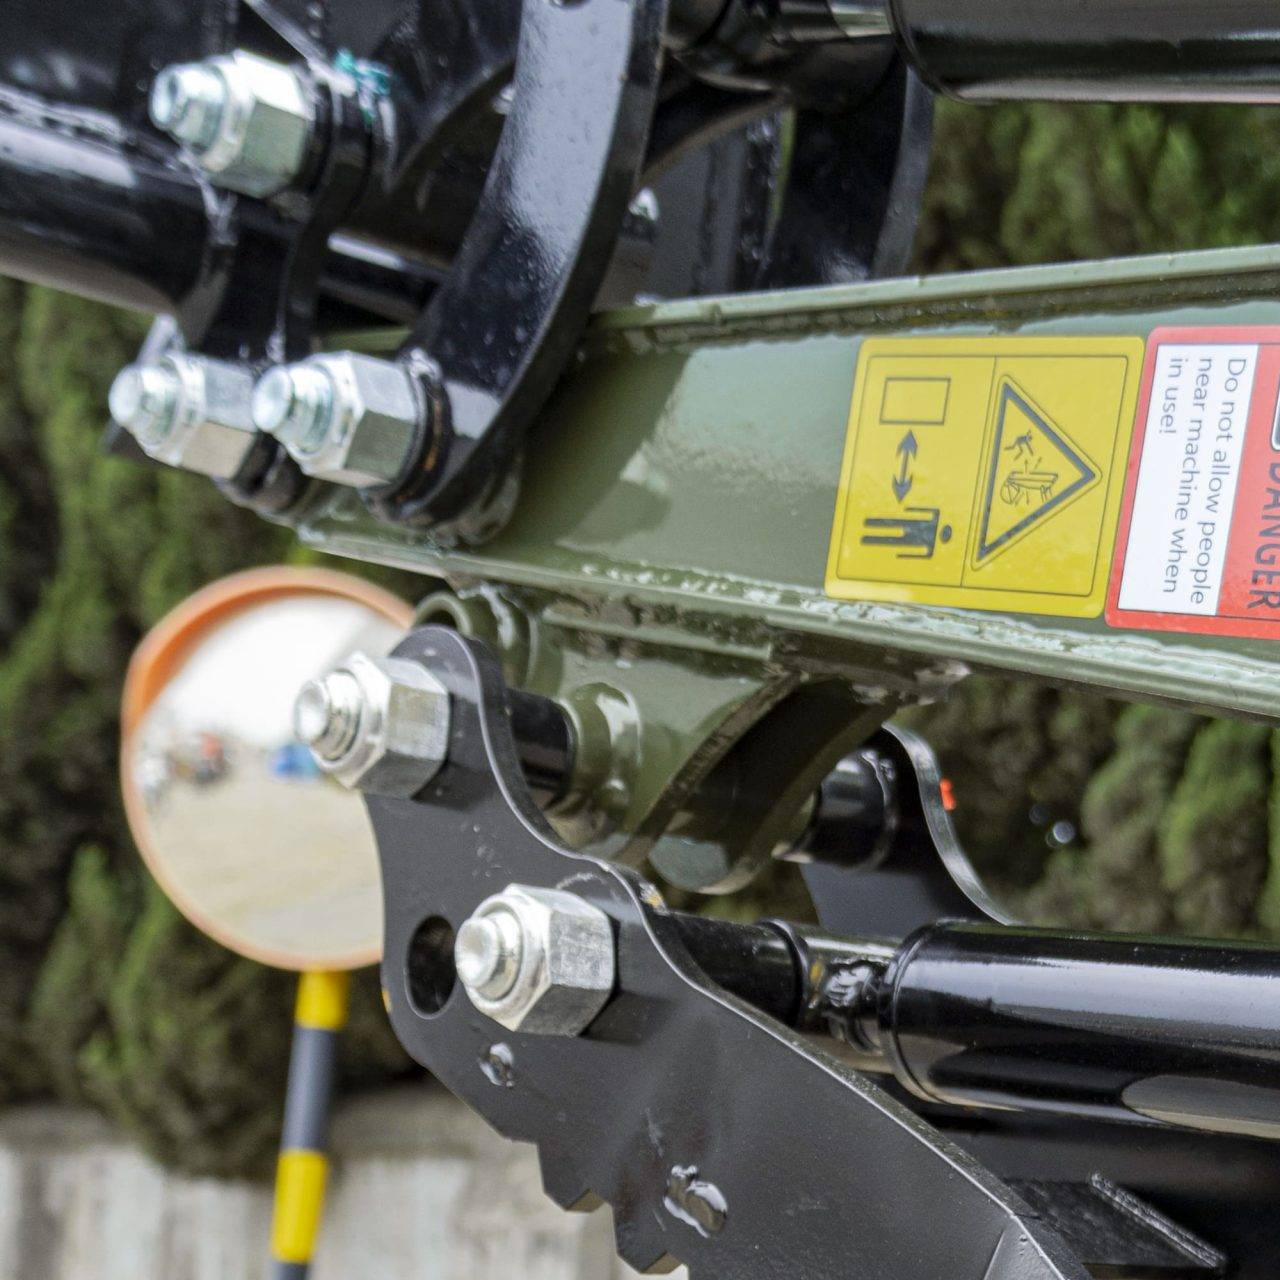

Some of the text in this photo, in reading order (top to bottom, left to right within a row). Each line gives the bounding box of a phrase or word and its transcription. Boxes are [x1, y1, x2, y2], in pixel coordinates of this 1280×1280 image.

[1158, 357, 1188, 434] in use!
[1163, 357, 1213, 594] near machine when
[1189, 358, 1247, 605] Do not allow people
